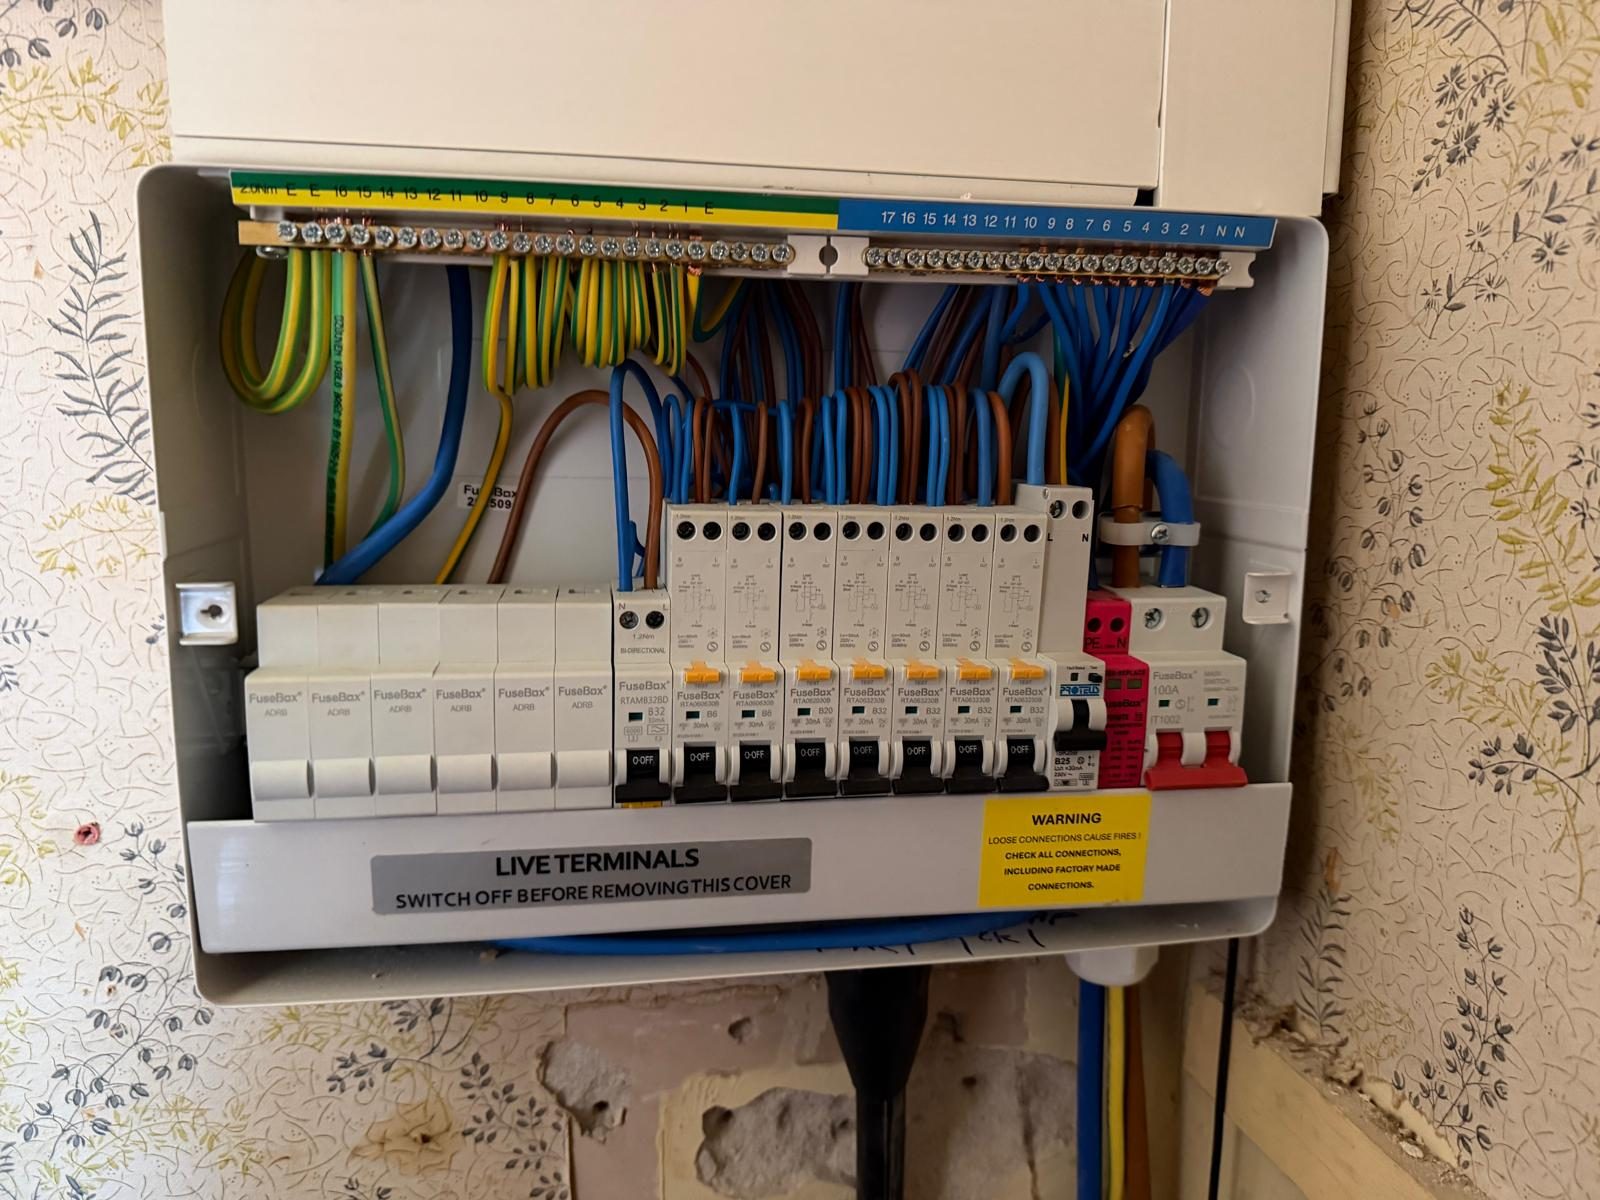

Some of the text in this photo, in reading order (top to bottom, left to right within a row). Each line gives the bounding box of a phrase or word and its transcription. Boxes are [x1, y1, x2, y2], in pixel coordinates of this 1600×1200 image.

[286, 185, 297, 197] E
[310, 186, 321, 197] E
[335, 186, 348, 198] 16
[358, 187, 372, 198] 15
[381, 187, 394, 199] 14
[403, 187, 418, 200] 13
[428, 188, 441, 201] 12
[451, 189, 463, 201] 11
[474, 190, 488, 202] 10
[500, 191, 509, 203] 9
[526, 193, 535, 205] 8
[549, 194, 557, 206] 7
[571, 195, 580, 207] 6
[593, 195, 602, 208] 5
[616, 197, 624, 209] 4
[638, 198, 647, 211] 3
[660, 199, 669, 212] 2
[683, 200, 688, 213] 1
[704, 202, 714, 215] E
[881, 211, 1246, 238] 17 16 15 14 13 12 11 10 9 8 7 6 5 4 3 2 1 N N
[464, 484, 518, 498] FuBox
[467, 497, 512, 509] 2509
[1047, 533, 1088, 542] L N
[1086, 637, 1101, 649] PE
[1117, 637, 1127, 649] N
[1154, 685, 1179, 695] 100A
[648, 707, 665, 716] B32
[706, 710, 718, 718] B6
[1032, 812, 1102, 826] WARNING
[988, 836, 1017, 845] LOOSE
[1018, 834, 1083, 844] CONNECTIONS
[1083, 832, 1112, 842] CAUSE
[1113, 832, 1137, 840] FIRES
[1005, 848, 1122, 860] CHECK ALL CONNECTIONS,
[496, 848, 700, 877] LIVE TERMINALS
[1004, 863, 1121, 876] INCLUDING FACTORY MADE
[396, 874, 791, 909] SWITCH OFF BEFORE REMOVING THIS COVER
[1027, 881, 1095, 891] CONNECTIONS.
